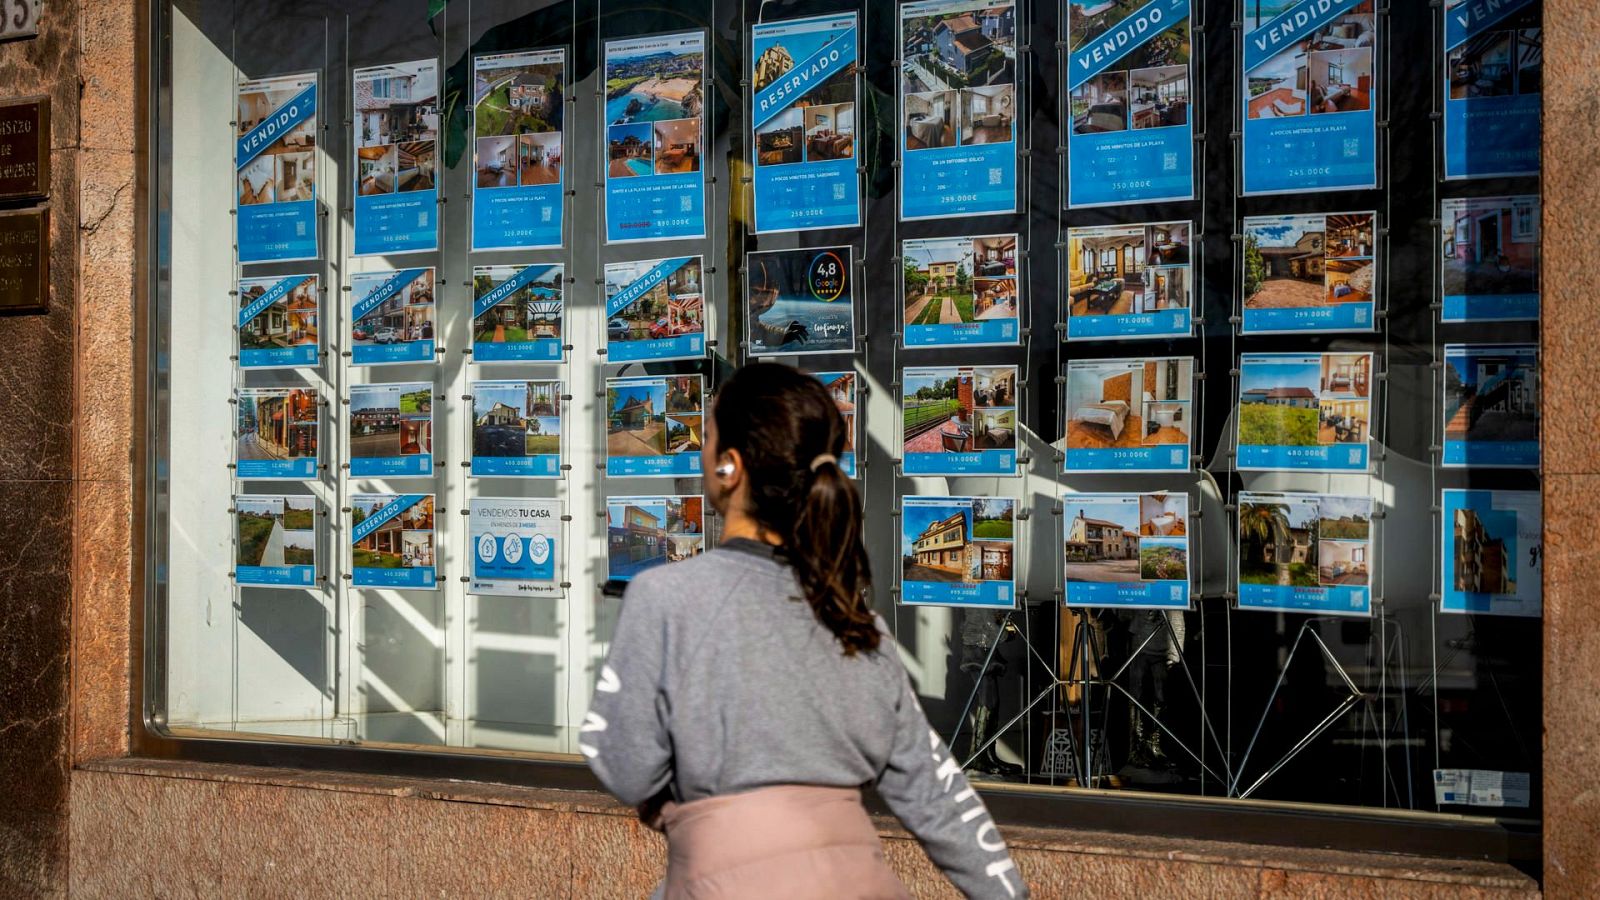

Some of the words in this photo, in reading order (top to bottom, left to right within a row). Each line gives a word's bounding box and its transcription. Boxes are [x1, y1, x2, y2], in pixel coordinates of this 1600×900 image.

[1255, 0, 1341, 51] VENDID
[1456, 0, 1512, 28] VEN
[1078, 7, 1163, 70] VENDIDO
[760, 50, 840, 112] RESERVADO
[242, 106, 298, 154] VENDIDO
[815, 278, 838, 288] Google
[817, 262, 836, 276] 4,8
[243, 284, 285, 318] RESERVADO
[360, 284, 393, 311] VENDIDO
[481, 279, 518, 308] VENDIDO
[612, 270, 662, 308] RESERVADO
[356, 503, 399, 536] RESERVADO
[478, 508, 518, 517] VENDEMOS
[519, 509, 528, 517] TU
[530, 509, 550, 518] CASA
